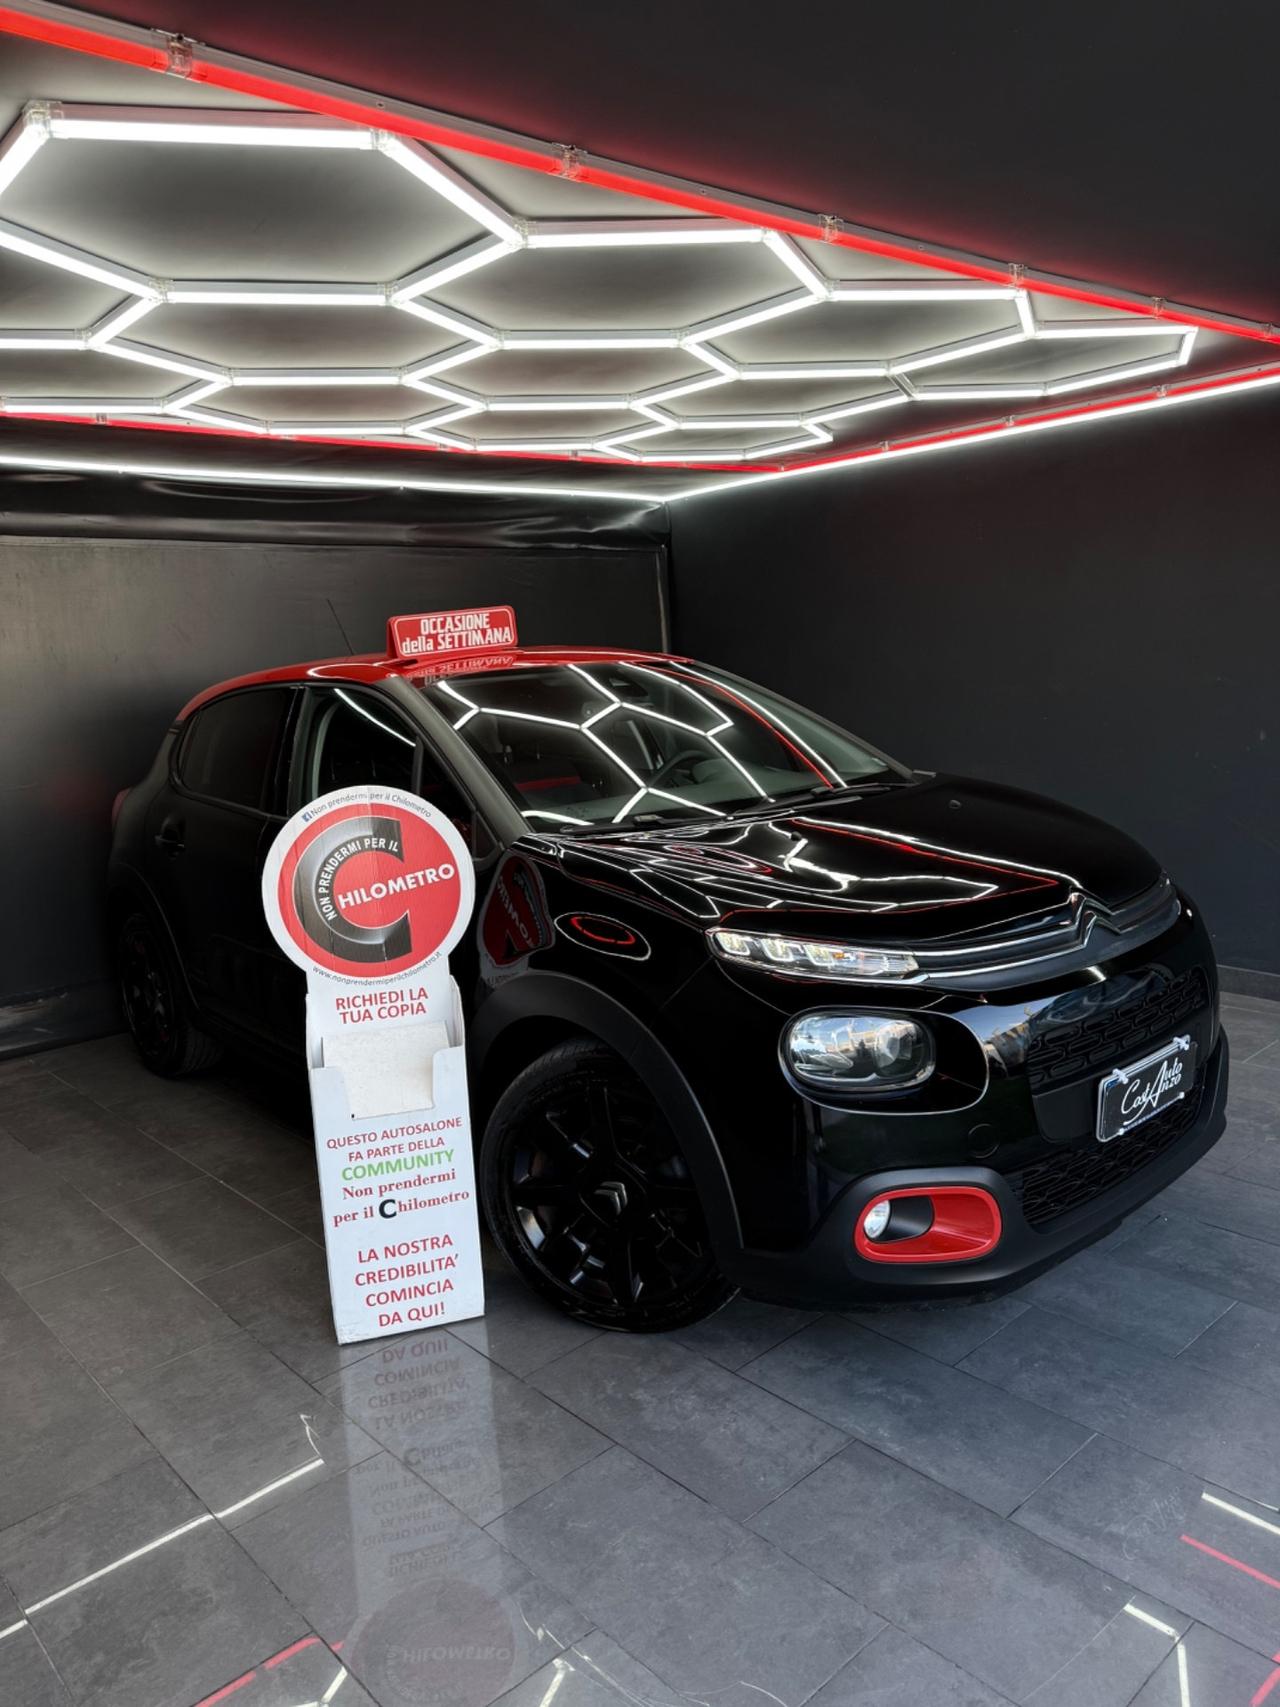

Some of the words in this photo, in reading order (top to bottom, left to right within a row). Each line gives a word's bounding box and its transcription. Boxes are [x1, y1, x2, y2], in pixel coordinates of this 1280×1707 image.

[420, 613, 490, 635] OCCASIONE
[402, 637, 434, 654] della
[437, 627, 511, 650] SETTIMANA
[310, 804, 327, 818] Non
[328, 794, 367, 807] prendermi
[370, 793, 383, 801] per
[385, 793, 391, 801] il
[392, 794, 432, 818] Chilometro
[364, 837, 386, 849] PER
[388, 841, 399, 852] IL
[319, 840, 362, 894] PRENDERMI
[319, 897, 338, 921] NON
[336, 990, 404, 1011] RICHIEDI
[409, 987, 428, 1000] LA
[339, 1009, 373, 1024] TUA
[377, 1002, 426, 1019] COPIA
[327, 1132, 377, 1149] QUESTO
[381, 1117, 462, 1140] AUTOSALONE
[348, 1152, 363, 1162] FA
[367, 1144, 404, 1159] PARTE
[408, 1137, 445, 1152] DELLA
[342, 1149, 454, 1181] COMMUNITY
[342, 1186, 373, 1200] Non
[378, 1168, 456, 1198] prendermi
[333, 1211, 359, 1227] per
[364, 1206, 374, 1219] il
[378, 1191, 470, 1219] Chilometro
[358, 1248, 379, 1263] LA
[384, 1234, 453, 1259] NOSTRA
[366, 1279, 454, 1307] COMINCIA
[379, 1312, 402, 1327] DA
[407, 1301, 445, 1321] QUI!
